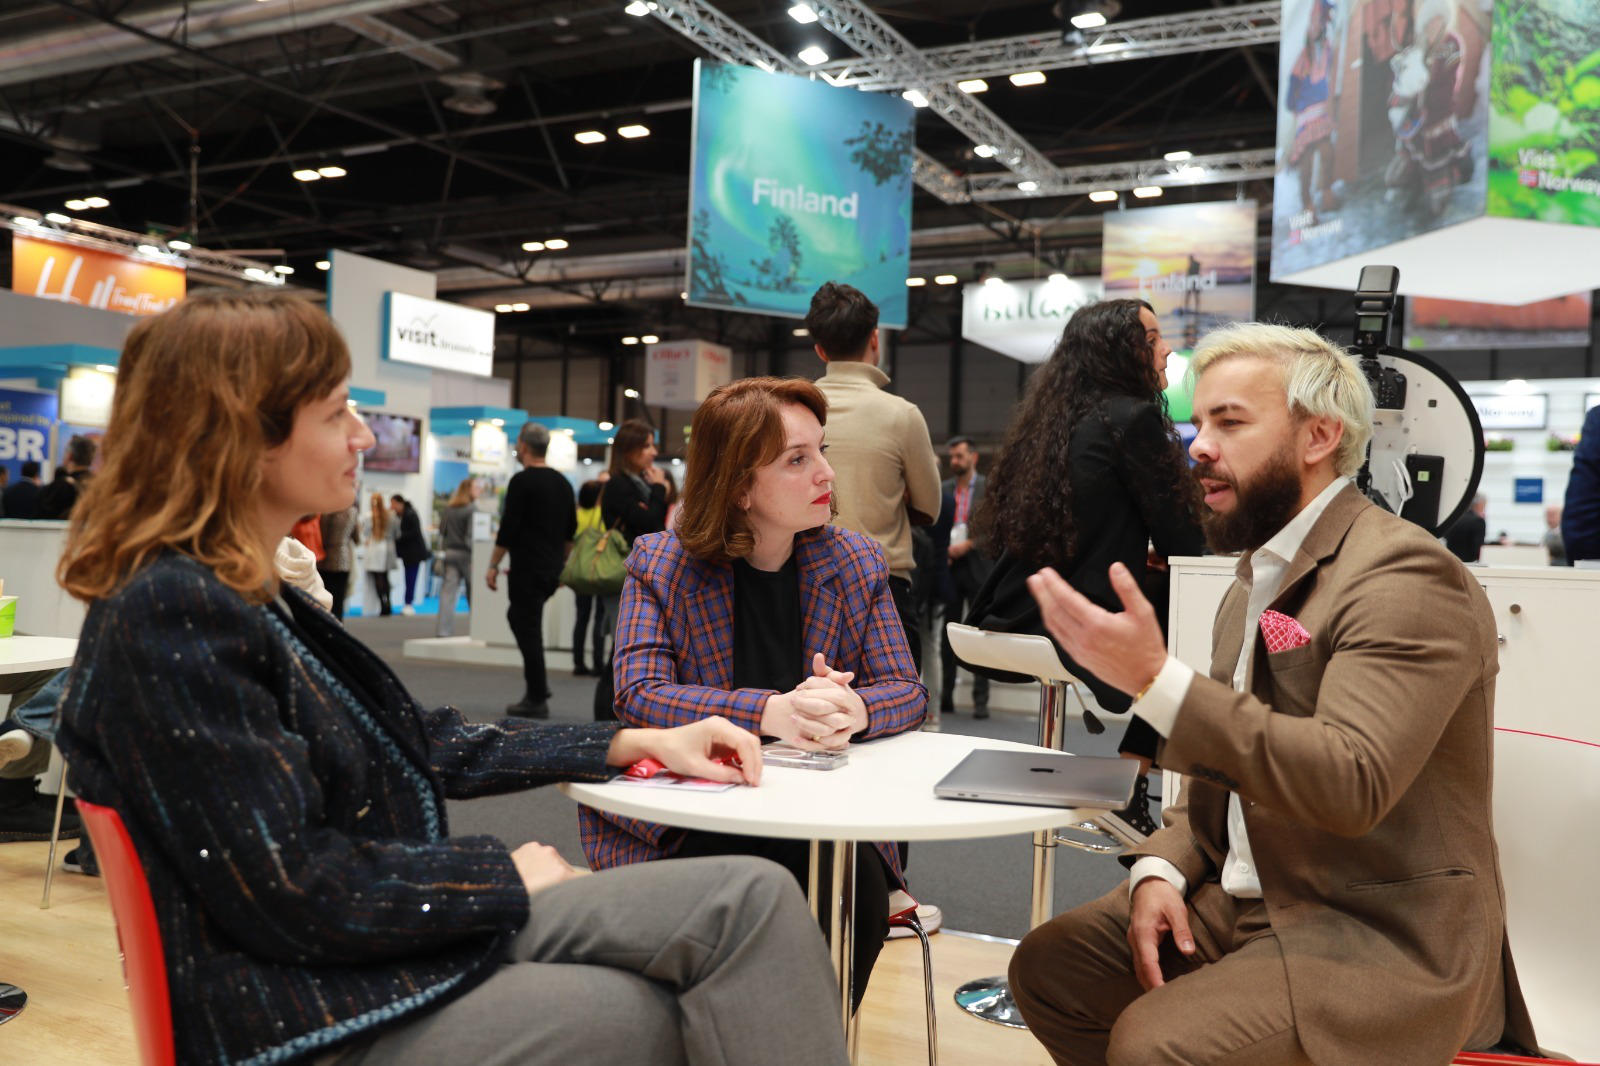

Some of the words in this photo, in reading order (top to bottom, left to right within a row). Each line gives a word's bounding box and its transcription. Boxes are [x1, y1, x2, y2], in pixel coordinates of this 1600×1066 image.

[1518, 148, 1556, 169] Visit
[752, 178, 859, 219] Finland
[1139, 269, 1217, 293] Finland
[397, 326, 437, 348] visit
